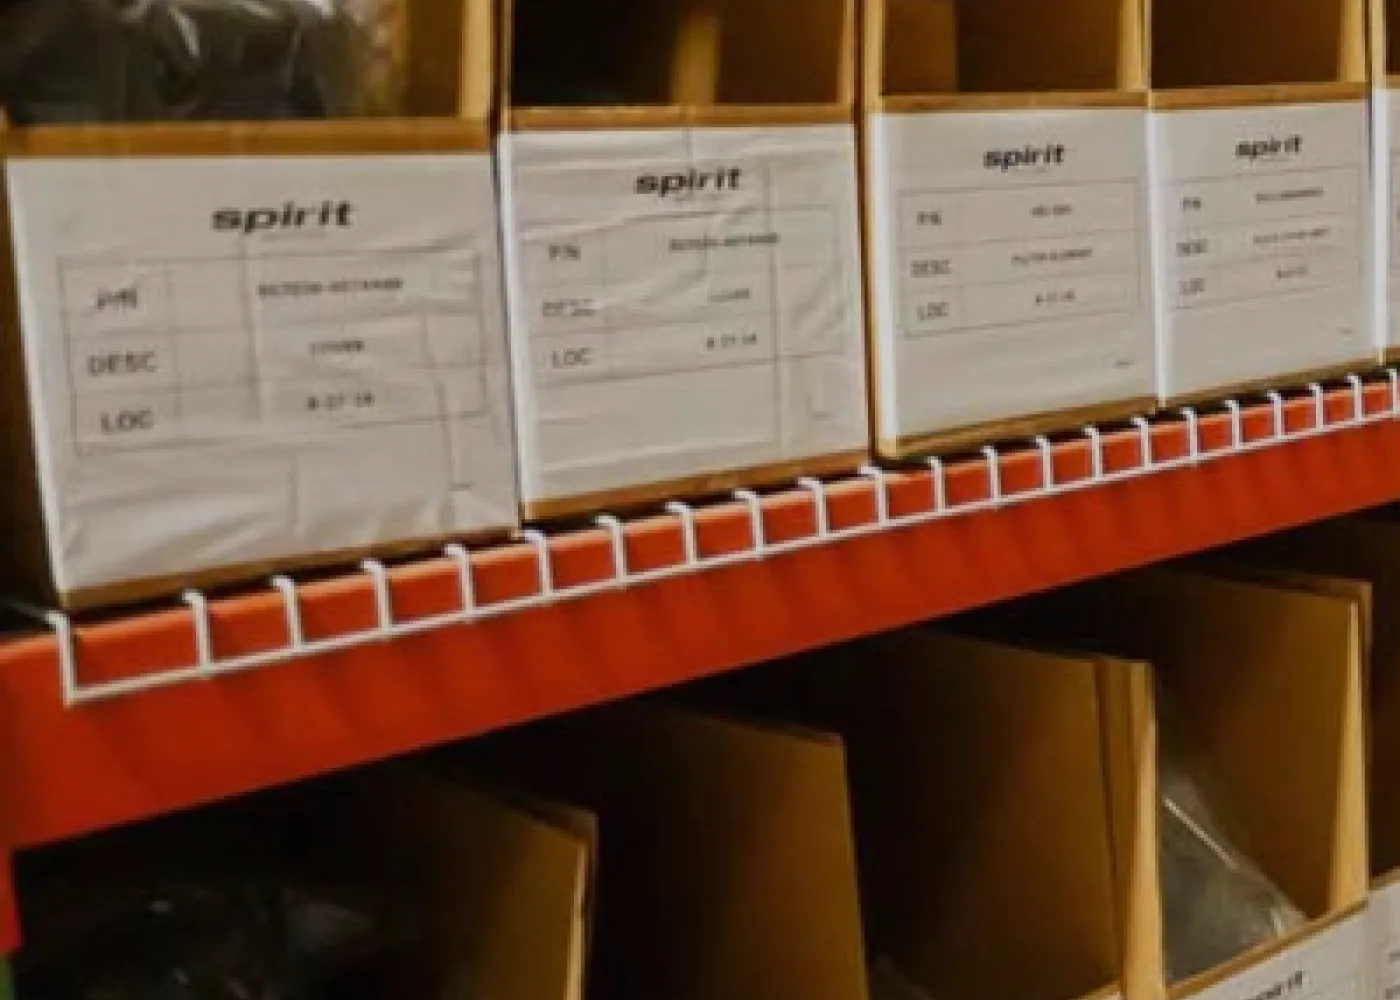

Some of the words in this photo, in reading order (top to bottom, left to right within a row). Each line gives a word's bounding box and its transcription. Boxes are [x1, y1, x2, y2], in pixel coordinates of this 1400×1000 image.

[982, 143, 1066, 172] spirit
[1235, 133, 1303, 160] spirit
[633, 165, 743, 198] spirit
[211, 199, 357, 233] spirit
[86, 350, 158, 376] DESC
[551, 347, 590, 369] LOC
[99, 409, 155, 434] LOC
